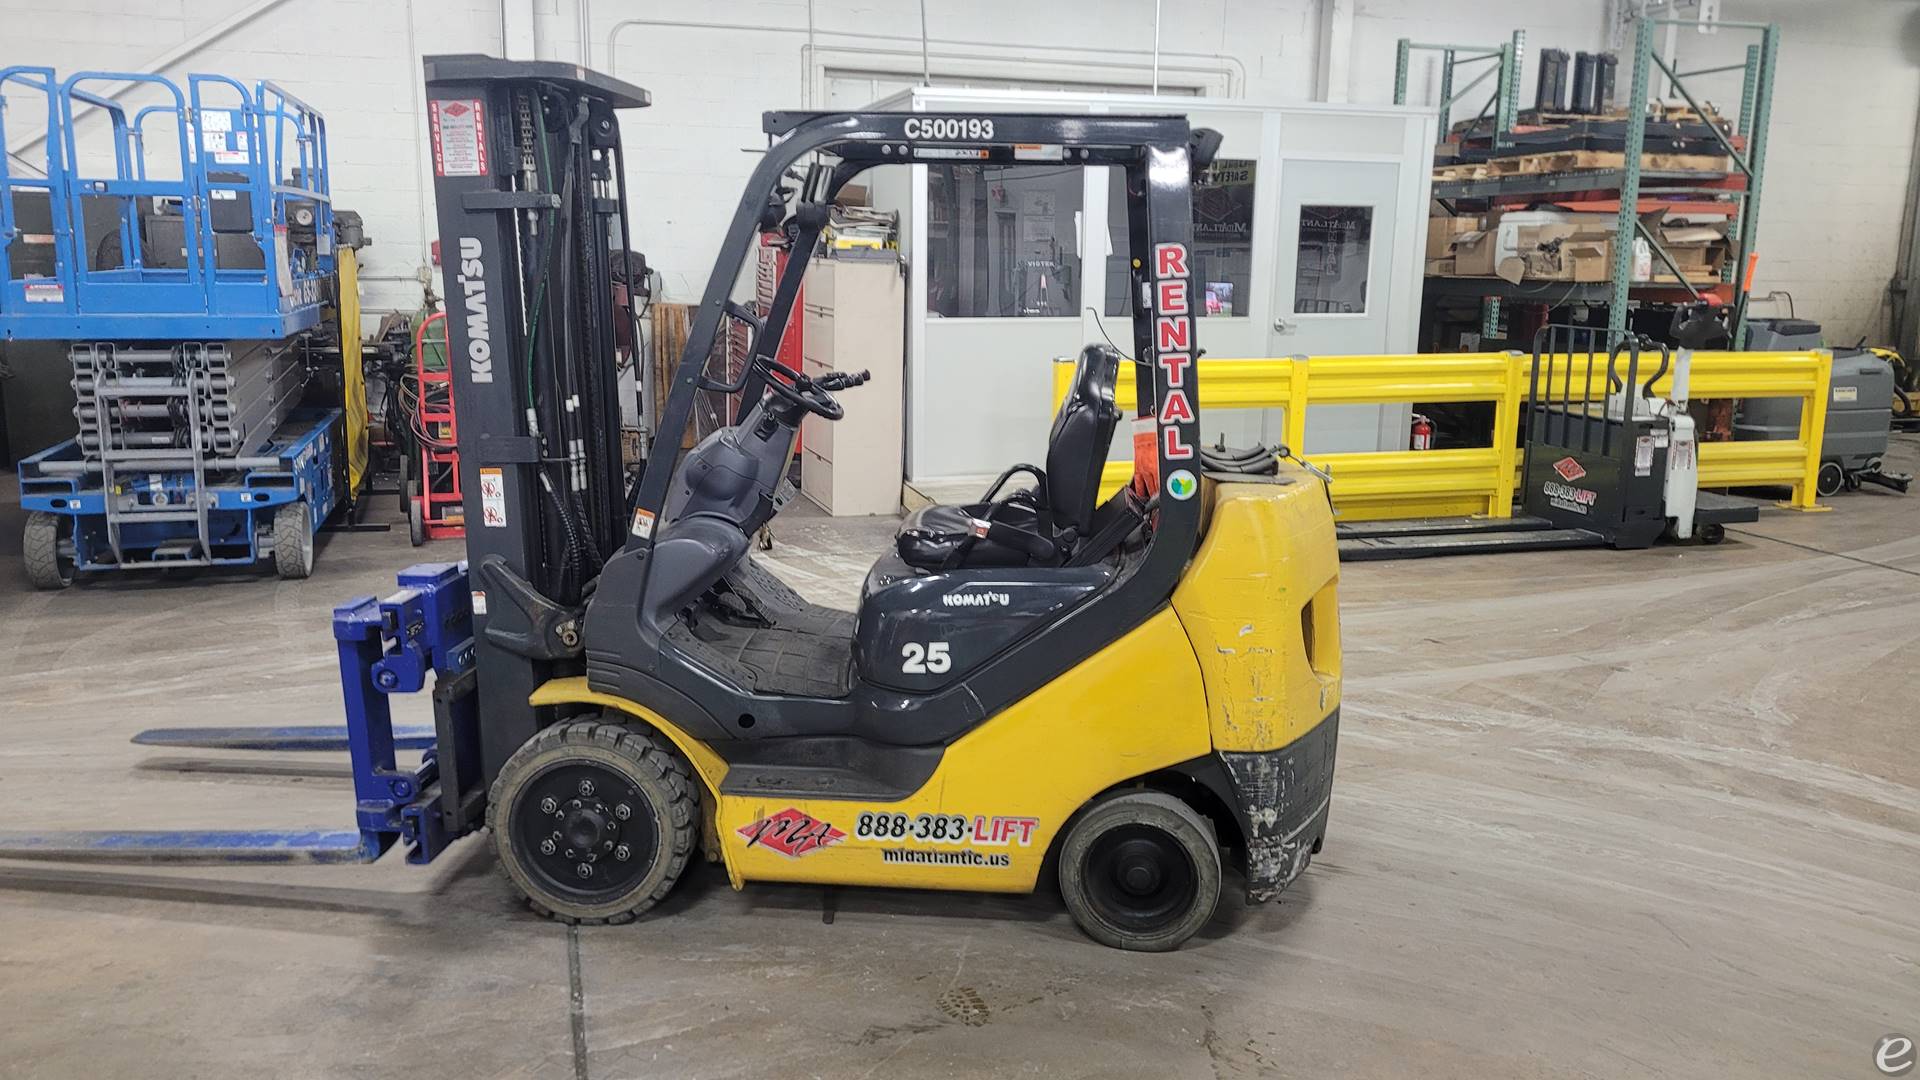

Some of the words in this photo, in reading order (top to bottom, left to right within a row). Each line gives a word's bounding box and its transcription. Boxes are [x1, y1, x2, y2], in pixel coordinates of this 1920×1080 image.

[431, 103, 443, 173] SERVICE
[474, 102, 486, 172] RENTALS
[904, 118, 994, 139] C500193
[457, 237, 493, 383] KOMATSU
[1156, 244, 1194, 459] RENTAL
[943, 591, 1009, 606] KOMATSU
[902, 642, 952, 674] 25
[882, 847, 1009, 867] midatlantic.us
